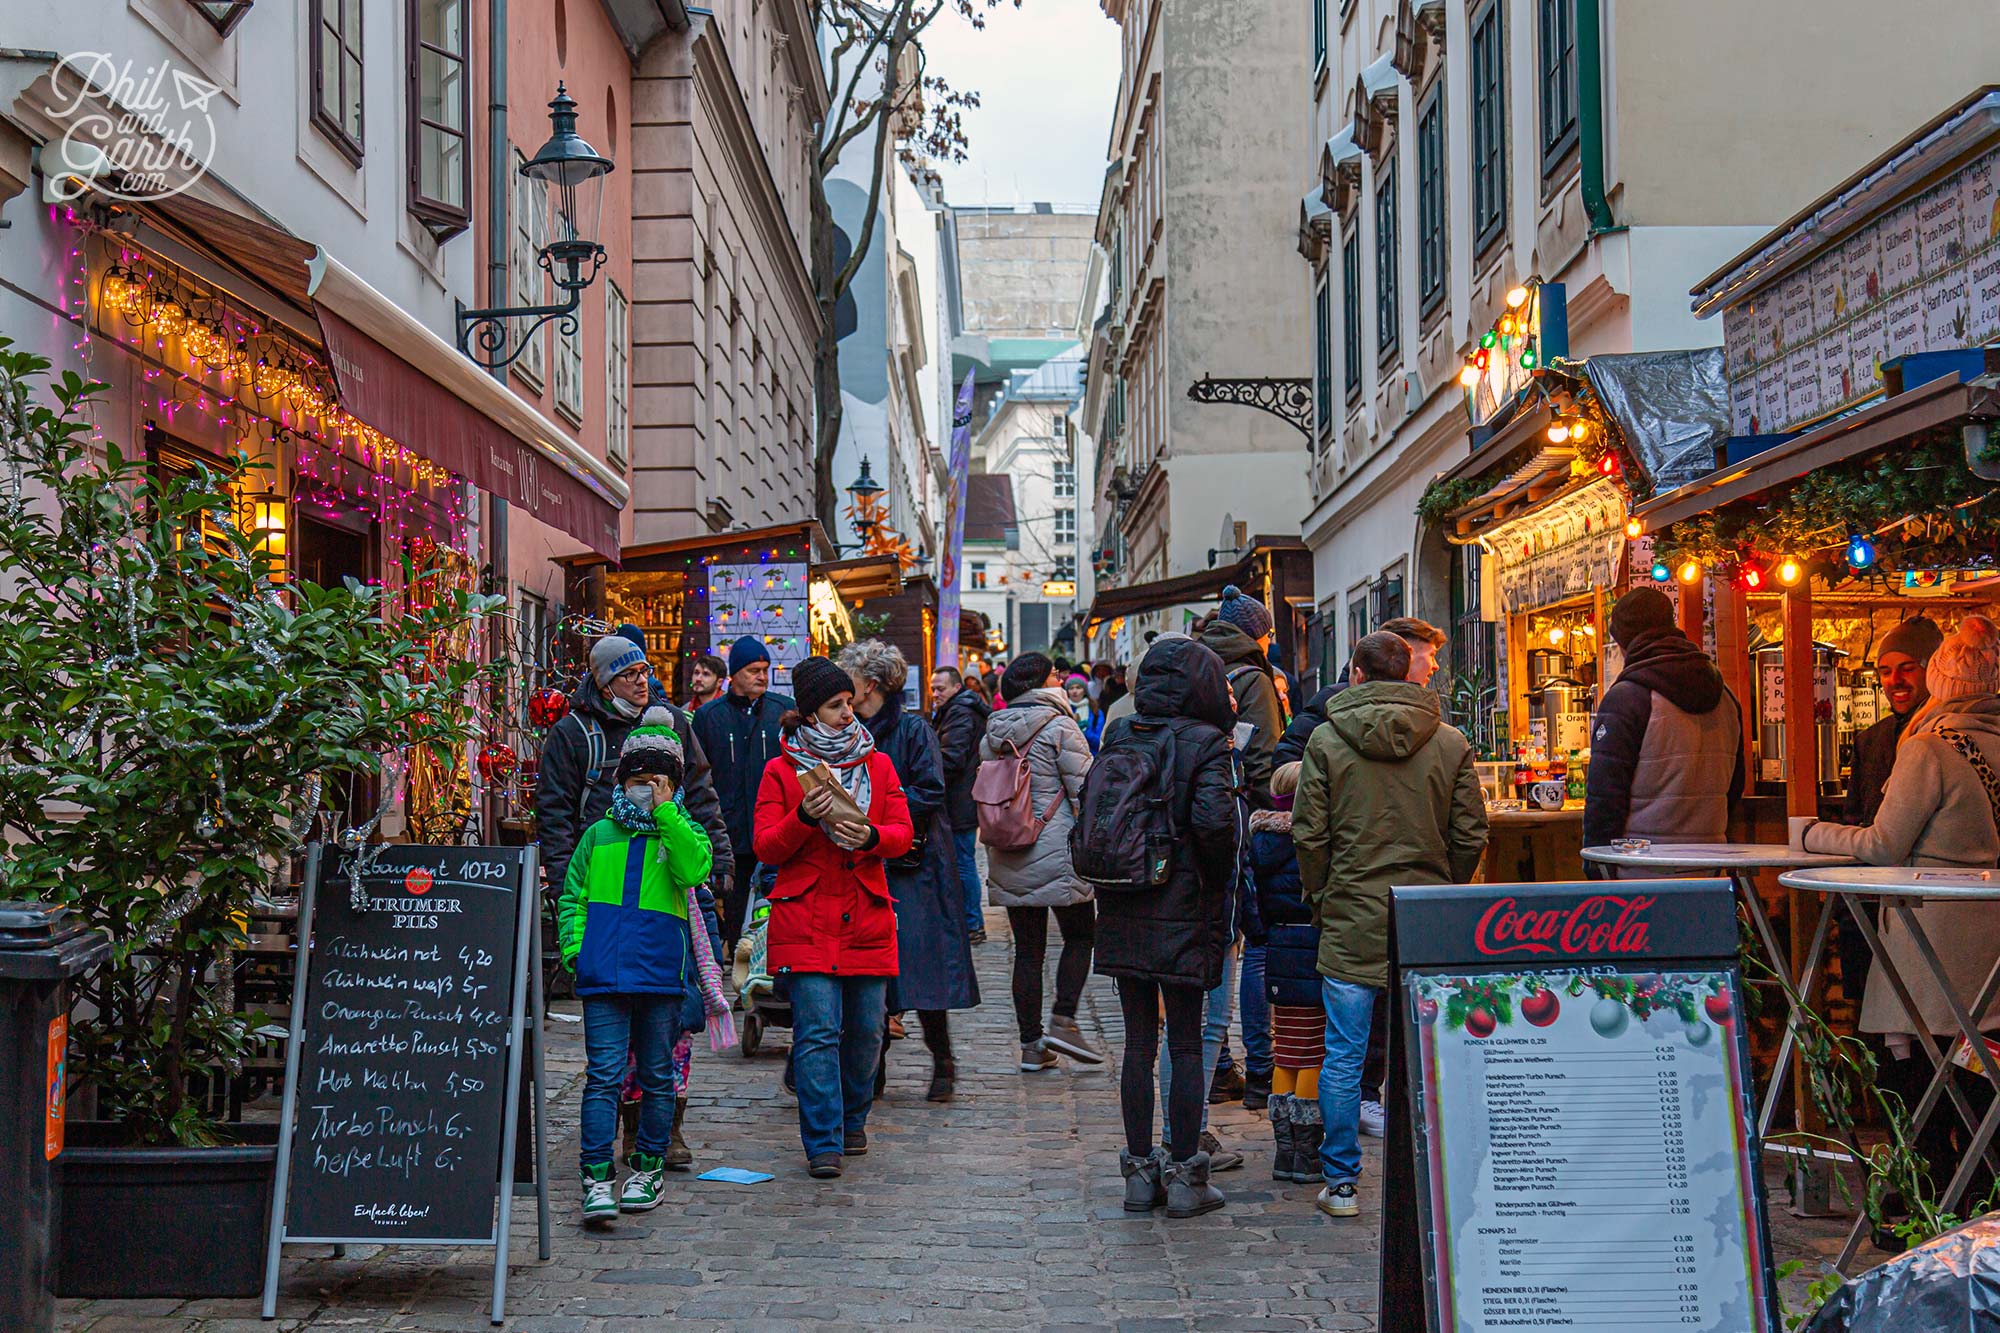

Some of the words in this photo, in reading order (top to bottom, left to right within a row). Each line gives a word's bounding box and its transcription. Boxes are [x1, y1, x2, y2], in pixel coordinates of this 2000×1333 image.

[1973, 182, 1993, 203] Punsch
[1938, 216, 1957, 236] Punsch
[1886, 226, 1913, 251] Glühwein
[1942, 280, 1965, 304] Punsch
[338, 854, 450, 878] Rstaurant
[459, 859, 506, 880] 1070
[371, 897, 463, 914] TRUMER
[392, 914, 438, 929] PILS
[458, 945, 493, 971] 4,20
[469, 1006, 503, 1028] 4,20
[318, 1032, 408, 1055] Amaretto
[411, 1030, 458, 1058] Punsch
[465, 1037, 497, 1060] 5,50
[317, 1067, 352, 1093] Hot
[443, 1071, 484, 1098] 5,50
[311, 1105, 374, 1141] Turbo
[376, 1106, 438, 1136] Punsch
[354, 1203, 397, 1220] Einfach
[399, 1203, 430, 1217] leben!
[1541, 1286, 1568, 1294] (Flasche)
